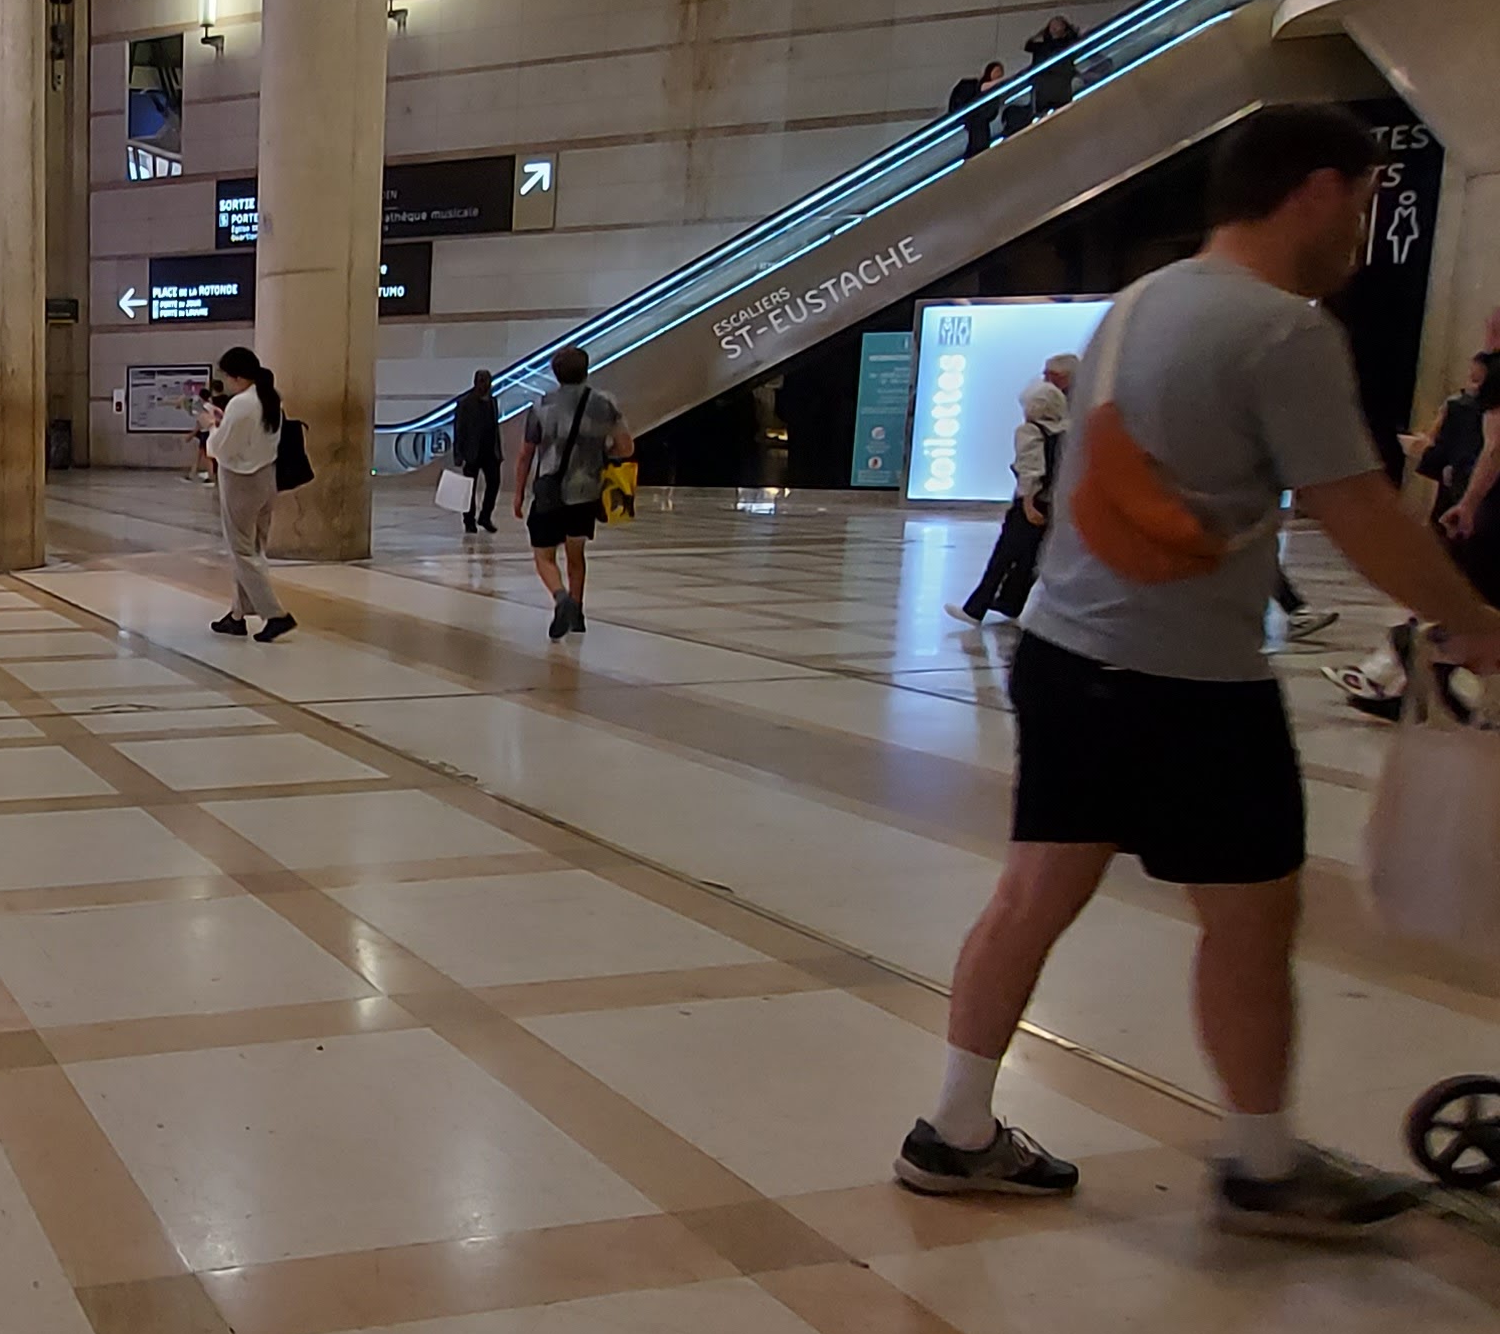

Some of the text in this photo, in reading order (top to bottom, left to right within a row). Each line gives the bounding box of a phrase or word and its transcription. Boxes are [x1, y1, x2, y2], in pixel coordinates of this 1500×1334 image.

[219, 198, 256, 212] SORTIE
[231, 213, 259, 224] PORTE
[430, 207, 479, 220] musicale
[152, 286, 178, 298] PLACE
[199, 283, 238, 296] ROTONDE
[720, 236, 923, 359] ST-EUSTACHE
[712, 287, 791, 337] ESCALIERS
[923, 354, 966, 492] toilettes
